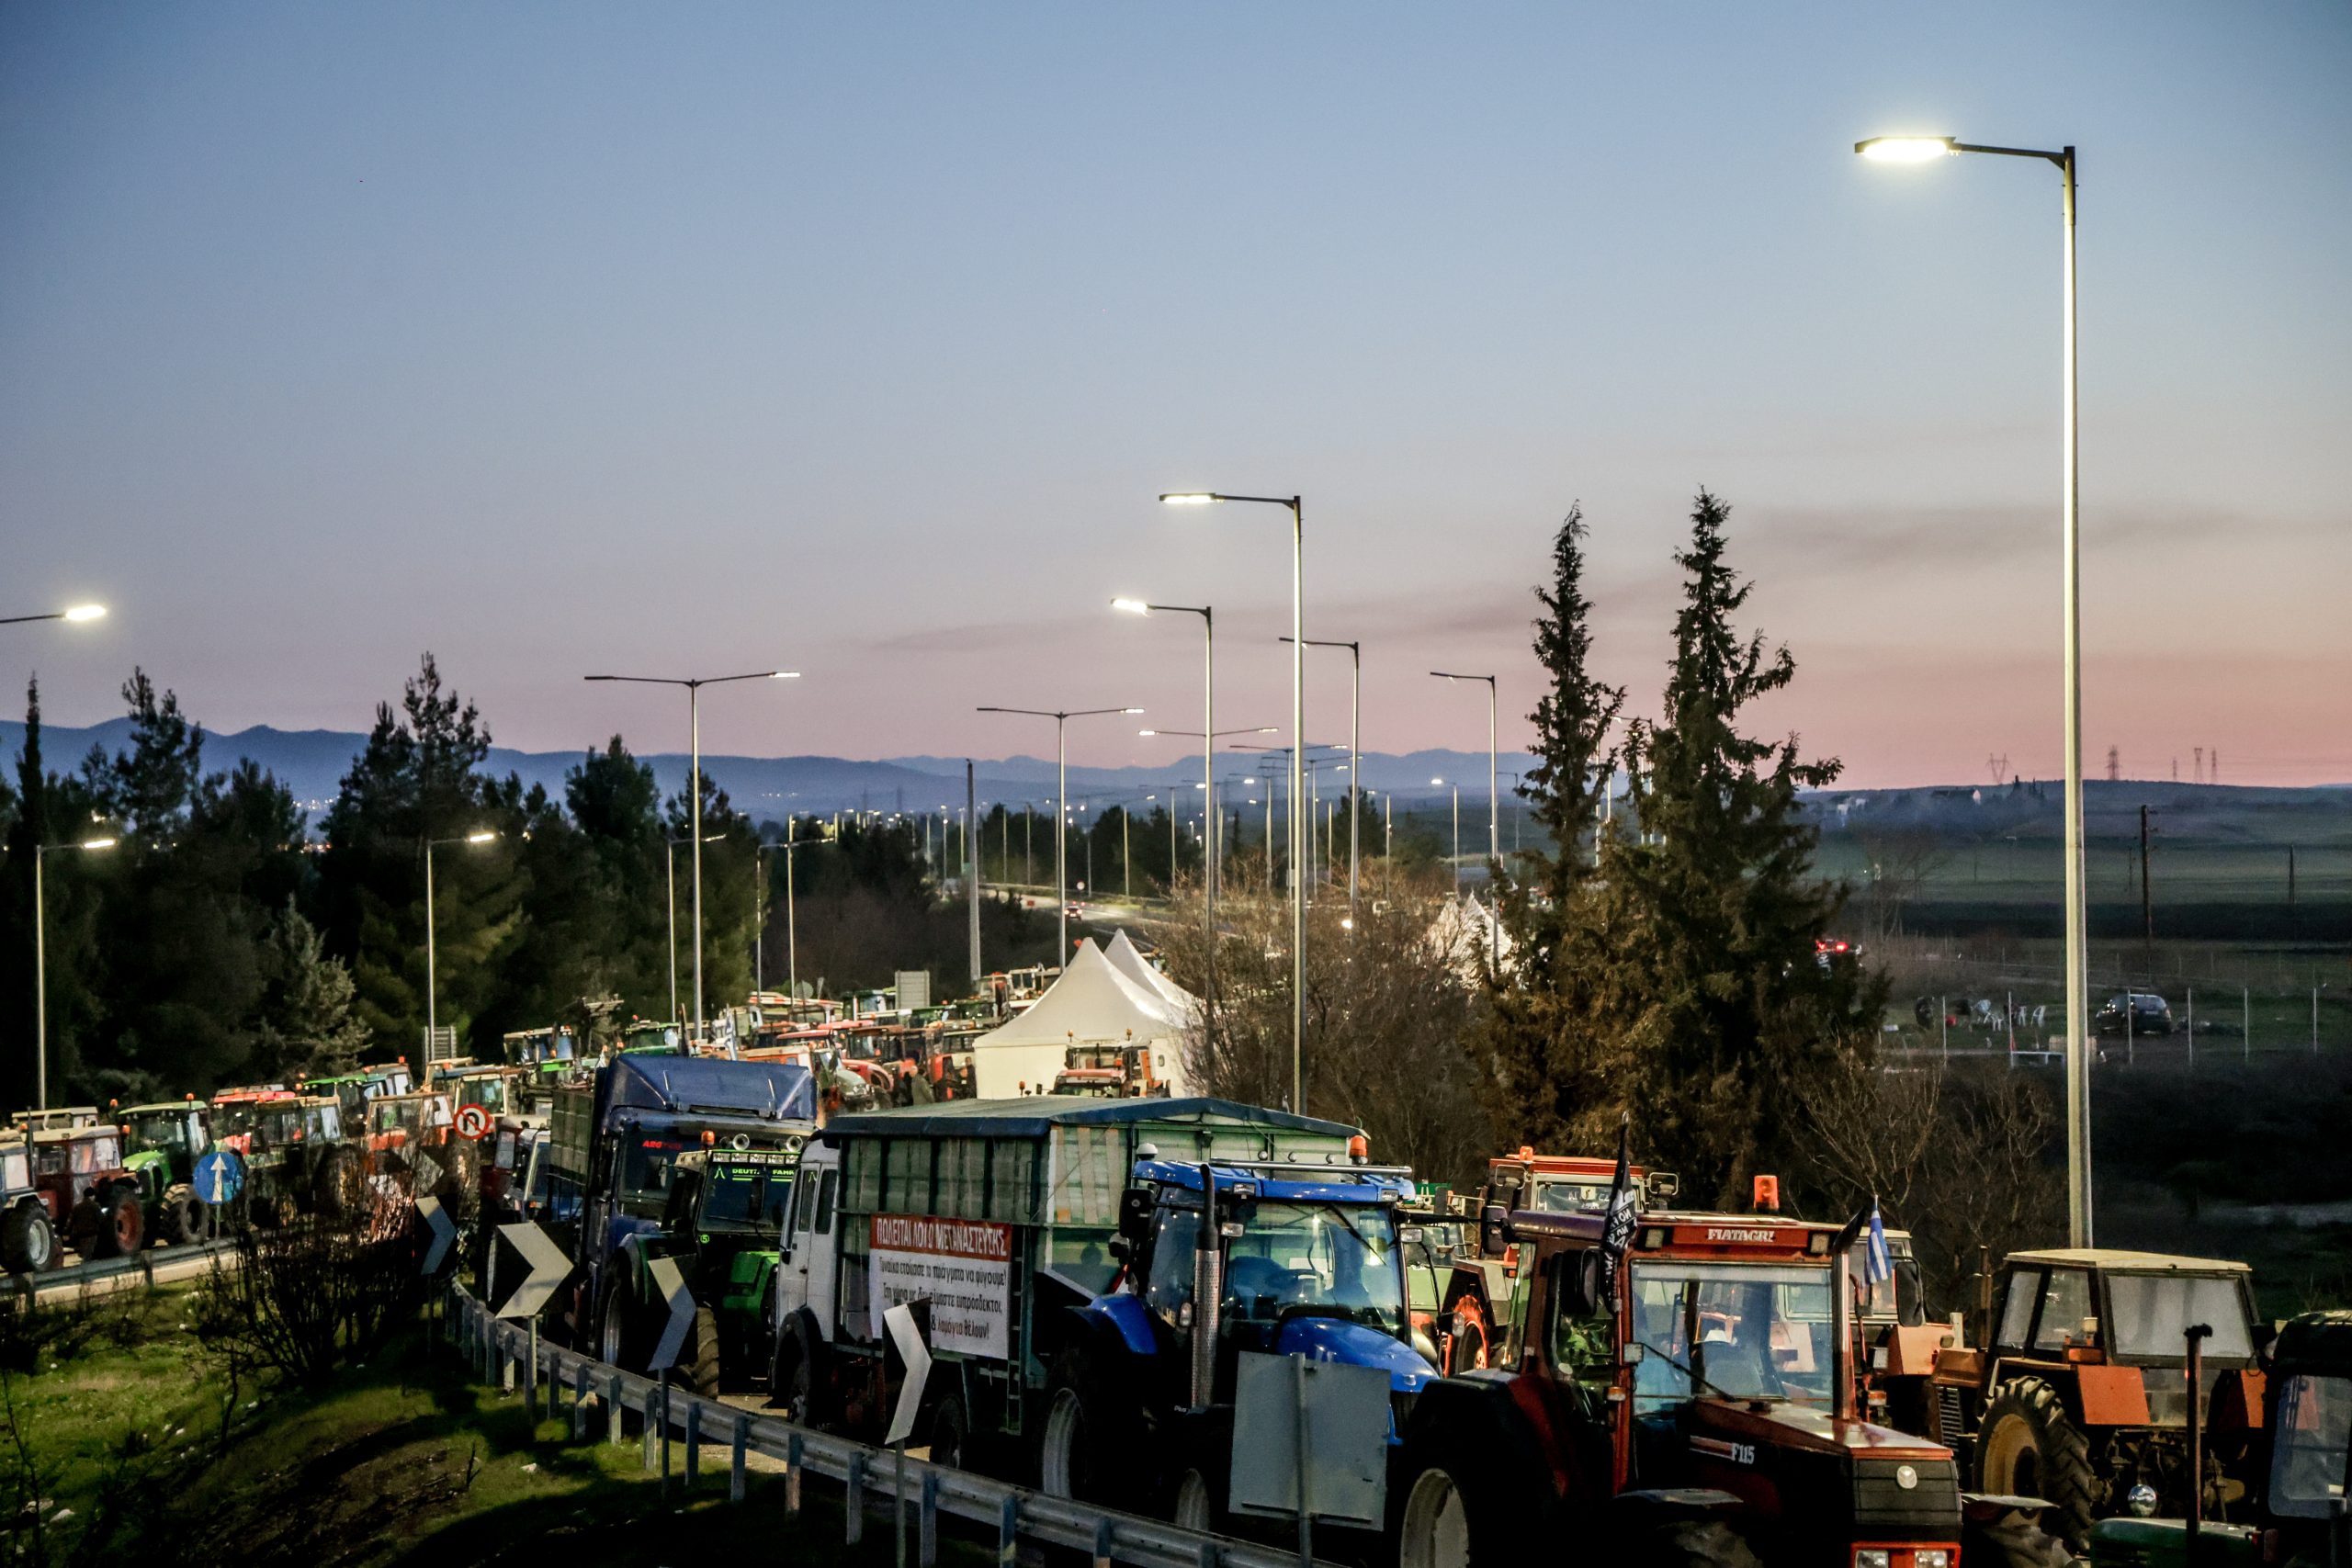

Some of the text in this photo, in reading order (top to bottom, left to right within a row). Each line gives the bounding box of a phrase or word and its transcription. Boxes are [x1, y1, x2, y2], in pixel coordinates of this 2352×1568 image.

[876, 1217, 912, 1247] ΠΩΛΕΙΤΑΙ
[935, 1223, 1008, 1257] ΜΕΤΑΝΑΣΤΕΥΣΗΣ
[1707, 1228, 1775, 1242] FIATAGRI
[1732, 1442, 1755, 1464] F115
